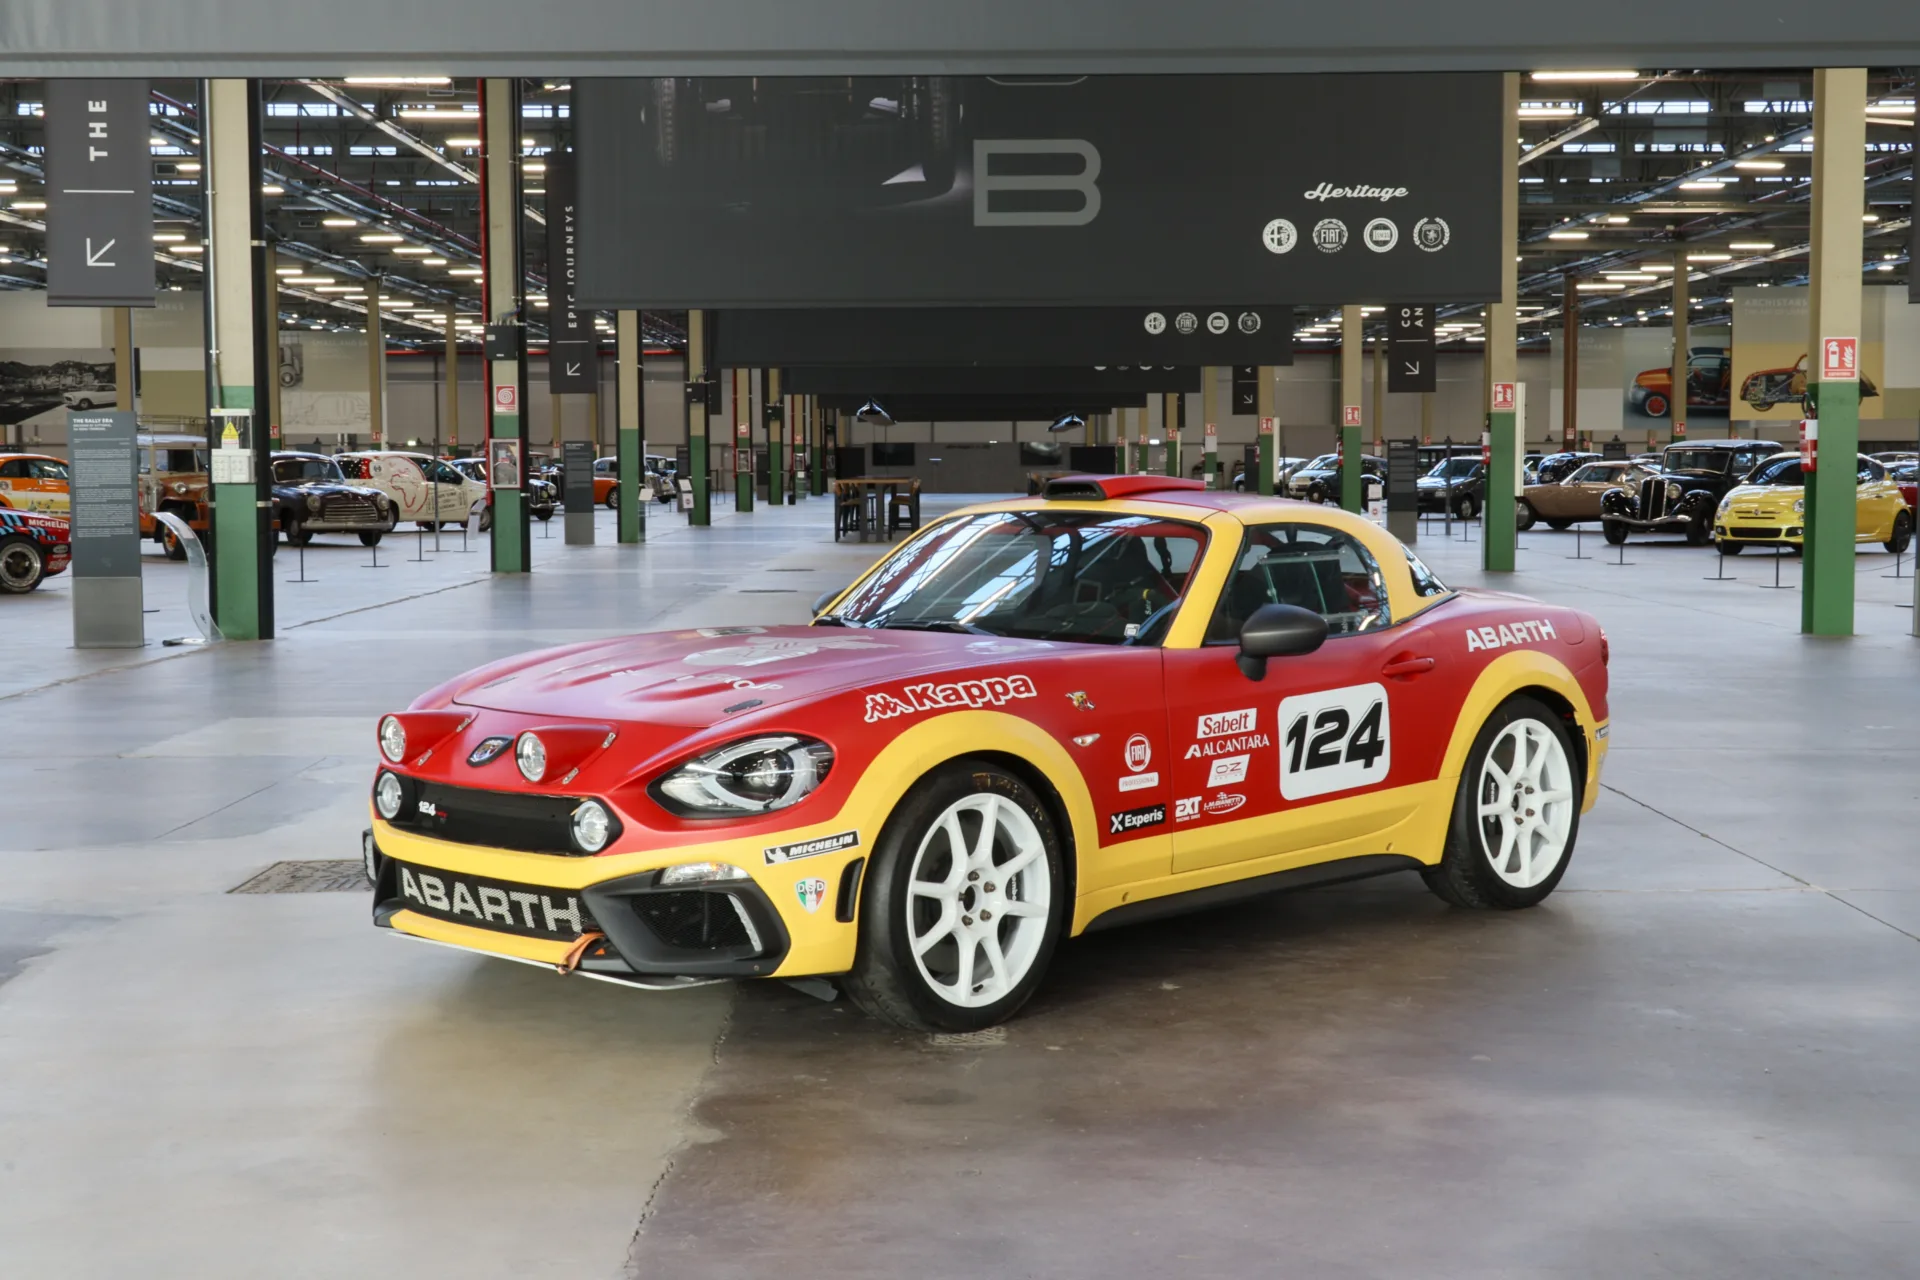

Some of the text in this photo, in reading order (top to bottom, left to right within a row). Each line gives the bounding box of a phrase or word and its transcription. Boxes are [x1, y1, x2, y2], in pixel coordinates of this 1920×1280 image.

[88, 100, 108, 162] THE
[973, 138, 1101, 227] B
[1304, 181, 1409, 202] Heritage
[1320, 229, 1341, 243] FIAT
[567, 294, 577, 328] EPIC
[1401, 308, 1411, 328] CO
[28, 518, 69, 529] MICHELIN
[1465, 618, 1557, 652] ABARTH
[904, 674, 1037, 711] Kappa
[1202, 712, 1249, 736] Sabelt
[1285, 698, 1385, 774] 124
[1131, 744, 1146, 762] FIAT
[1203, 733, 1270, 757] ALCANTARA
[418, 800, 436, 816] 124
[1125, 809, 1163, 828] Experis
[789, 834, 853, 856] MICHELIN
[401, 867, 583, 934] ABARTH
